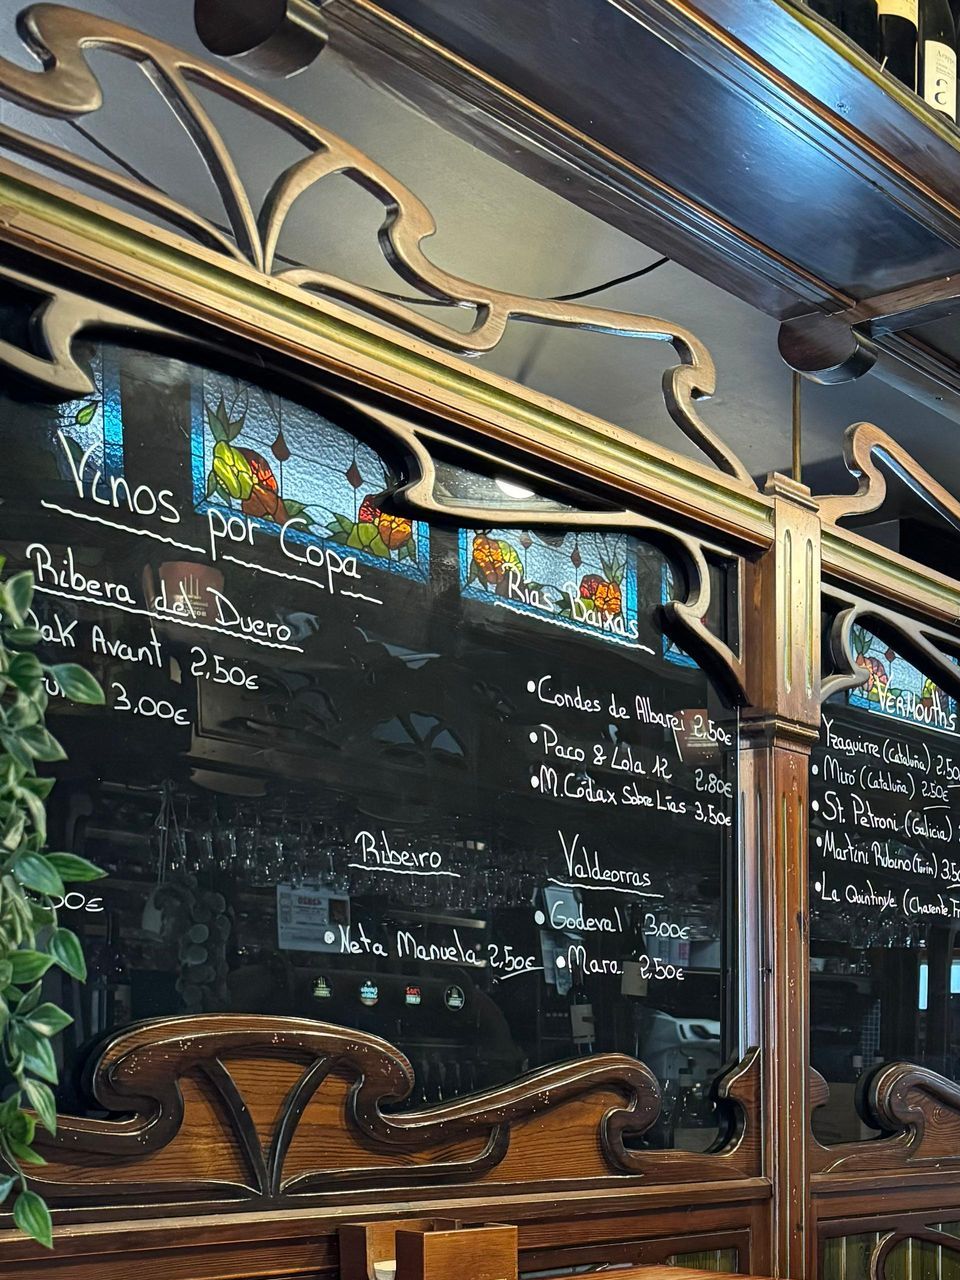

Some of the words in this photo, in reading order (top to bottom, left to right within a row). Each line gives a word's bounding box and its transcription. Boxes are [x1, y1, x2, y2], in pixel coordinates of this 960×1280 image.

[57, 429, 181, 524] Vinos
[207, 508, 261, 562] por
[279, 517, 362, 594] Copa
[25, 543, 136, 605] Ribera
[154, 579, 198, 619] del
[206, 586, 292, 643] Duero
[562, 581, 639, 640] Baixas
[91, 624, 163, 668] Avant
[190, 646, 260, 691] 2,50€
[111, 682, 191, 726] 3,00€
[538, 674, 601, 712] Condes
[608, 693, 630, 719] de
[635, 695, 686, 731] Albarei
[694, 714, 732, 746] 2,50€
[540, 724, 585, 762] Paco
[593, 744, 607, 766] &
[611, 746, 646, 774] Lola
[694, 768, 733, 799] 2,80€
[821, 713, 881, 757] Yzaguirre
[882, 738, 931, 775] (Cataluña)
[823, 754, 857, 785] Miró
[859, 765, 915, 801] (Cataluña)
[694, 801, 732, 827] 3,50€
[822, 791, 846, 824] St.
[850, 793, 899, 831] Petroni
[904, 809, 953, 843] (Galicia)
[355, 829, 442, 868] Ribeiro
[558, 829, 652, 887] Valdeorras
[823, 830, 870, 865] Martini
[820, 870, 841, 902] La
[845, 880, 898, 912] Quintinye
[550, 900, 623, 933] Godeval
[644, 913, 691, 940] 3,00€
[338, 922, 389, 957] Neta
[396, 928, 482, 966] Manuela
[487, 943, 536, 971] 2,50€
[639, 954, 685, 980] 2,50€
